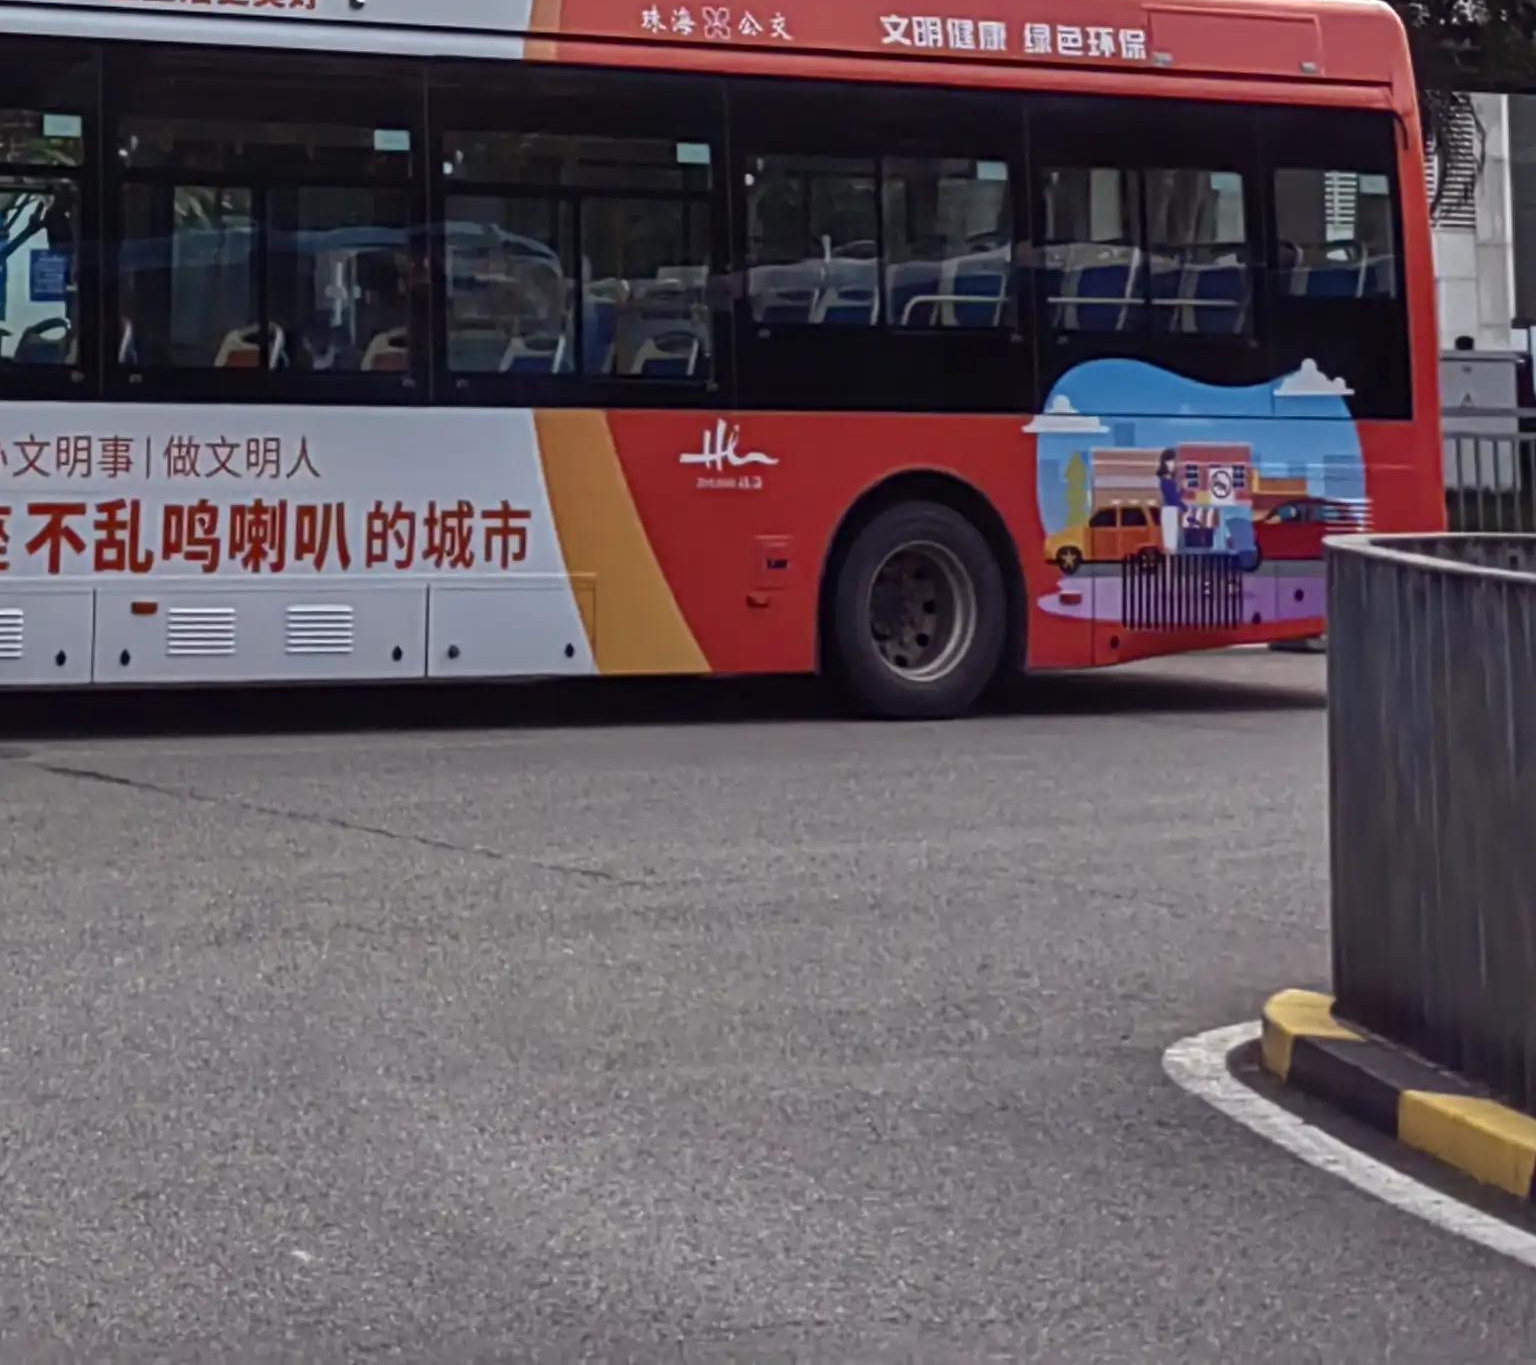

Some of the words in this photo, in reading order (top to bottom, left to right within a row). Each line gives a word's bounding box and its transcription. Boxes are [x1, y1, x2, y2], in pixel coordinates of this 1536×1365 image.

[879, 14, 1007, 51] 文明健康
[1024, 22, 1147, 59] 绿色环保
